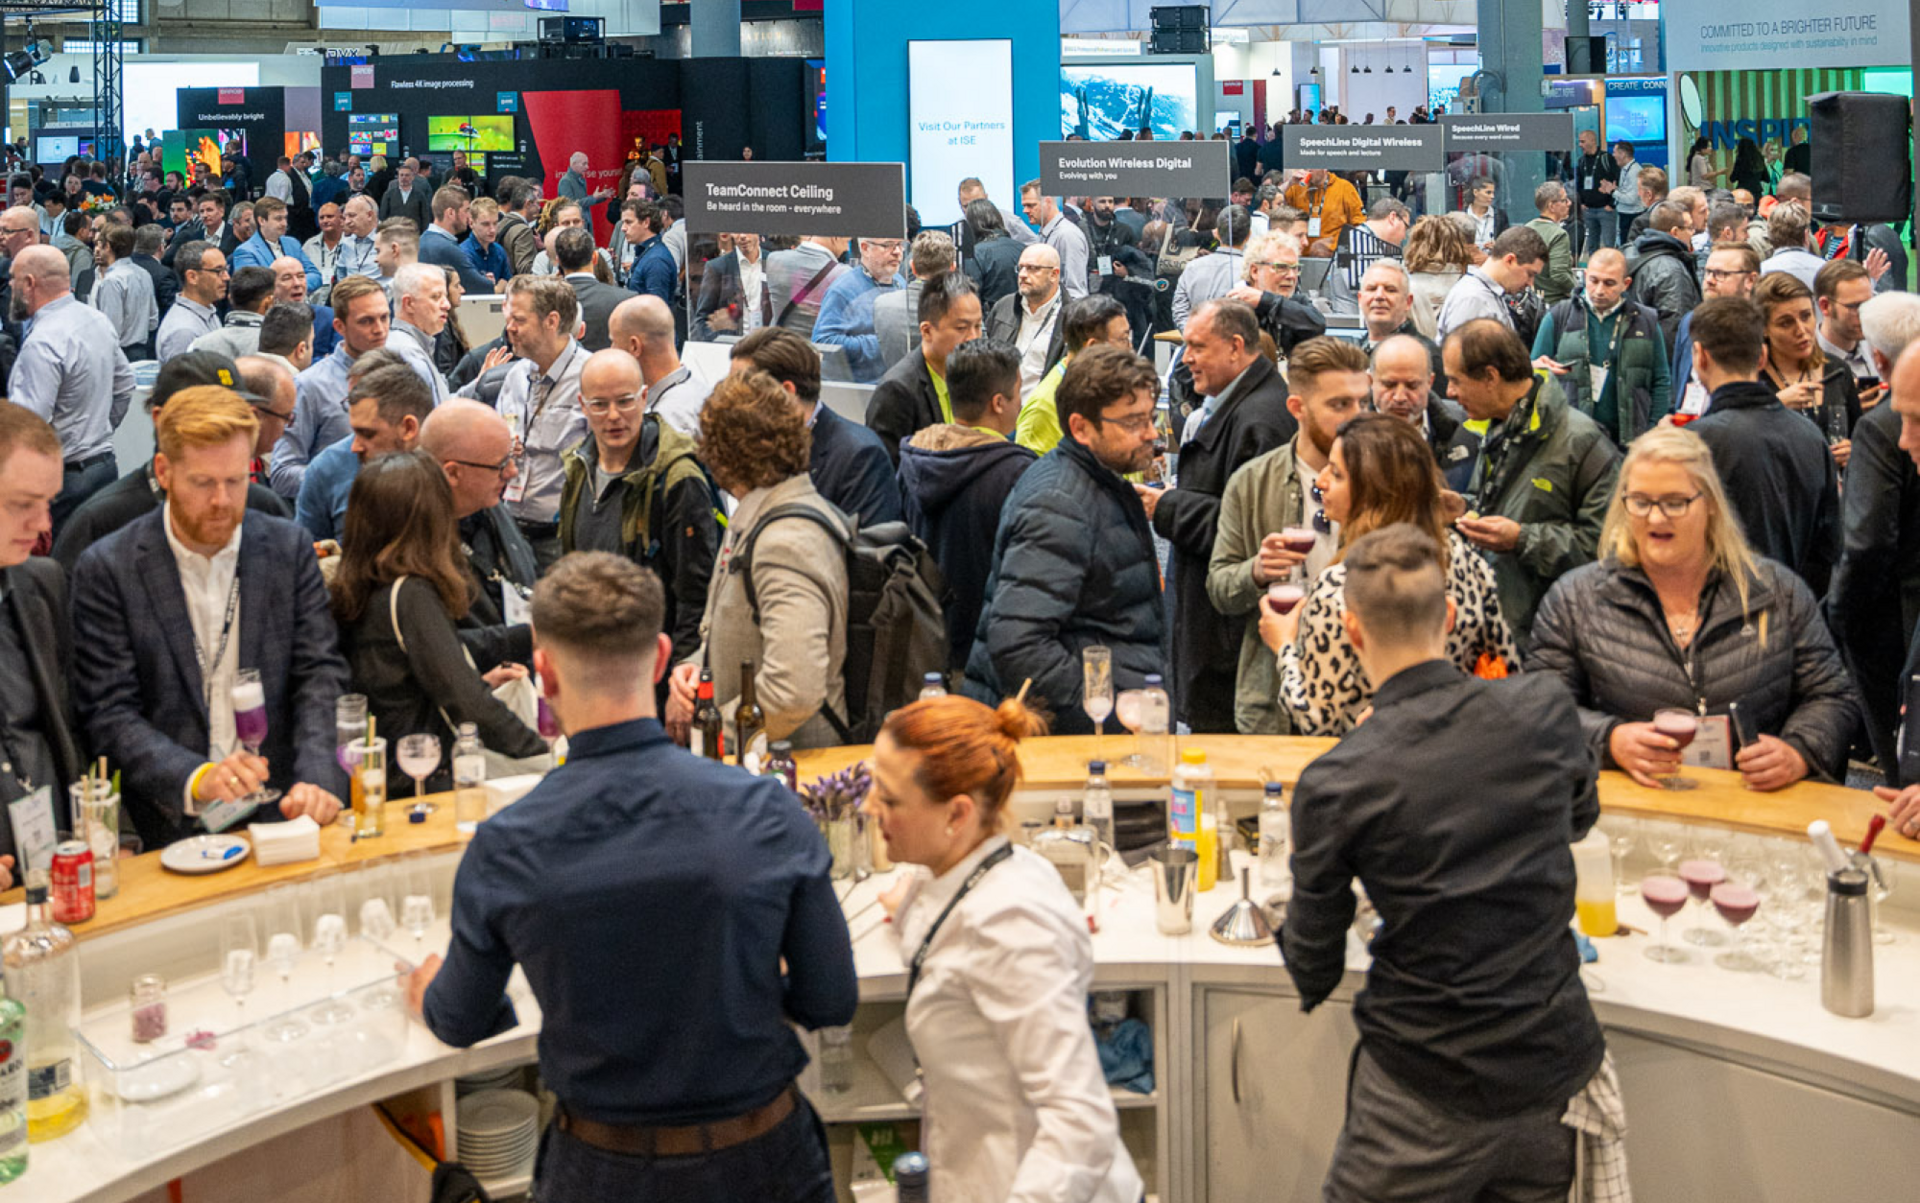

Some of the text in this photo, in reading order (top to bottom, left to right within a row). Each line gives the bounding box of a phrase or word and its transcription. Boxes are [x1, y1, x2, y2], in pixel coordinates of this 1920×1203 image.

[1701, 15, 1877, 39] COMMITTED TO A BRIGHTER FUTURE
[1761, 41, 1789, 52] designed
[1790, 40, 1805, 49] with
[1806, 38, 1849, 48] sustainability
[1850, 37, 1858, 46] in
[1859, 36, 1878, 46] mind
[391, 78, 475, 90] Flawless 4K image processing
[198, 112, 265, 122] Unbelievably bright
[918, 120, 1006, 131] Visit Our Partners
[1452, 124, 1520, 133] SpeechLine Wired
[947, 135, 977, 145] at ISE
[1300, 137, 1423, 148] SpeechLine Digital Wireless
[1326, 149, 1347, 157] speech
[1058, 157, 1192, 171] Evolution Wireless Digital
[1059, 171, 1118, 181] Evolving with you
[705, 182, 834, 201] TeamConnect Ceiling
[706, 201, 718, 211] Be
[718, 201, 741, 211] heard
[742, 202, 751, 212] in
[751, 202, 764, 212] the
[765, 203, 787, 213] room
[793, 203, 842, 215] everywhere
